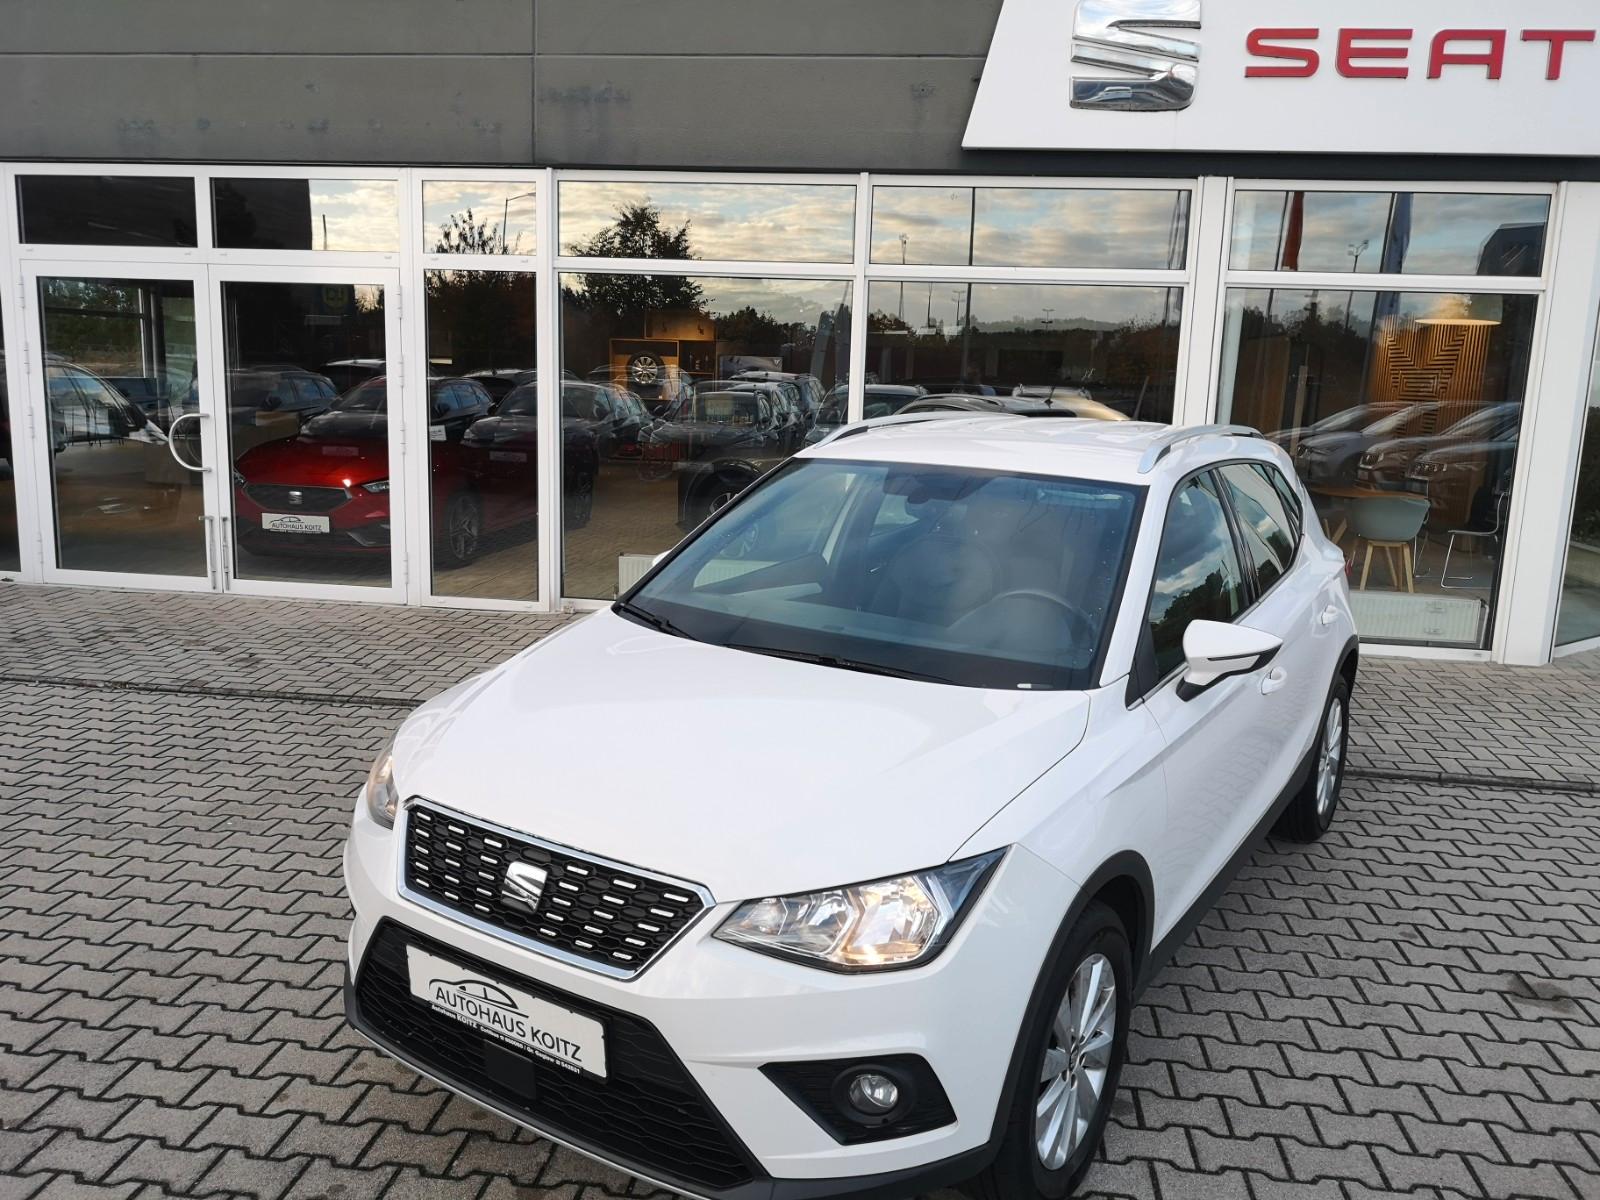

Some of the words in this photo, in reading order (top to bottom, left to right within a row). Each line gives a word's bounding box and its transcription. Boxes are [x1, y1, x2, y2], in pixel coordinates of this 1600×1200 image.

[1244, 27, 1597, 81] SEAT
[435, 986, 527, 1038] AUTOHAUS
[530, 1026, 582, 1062] KOITZ
[457, 1013, 478, 1029] KOITZ
